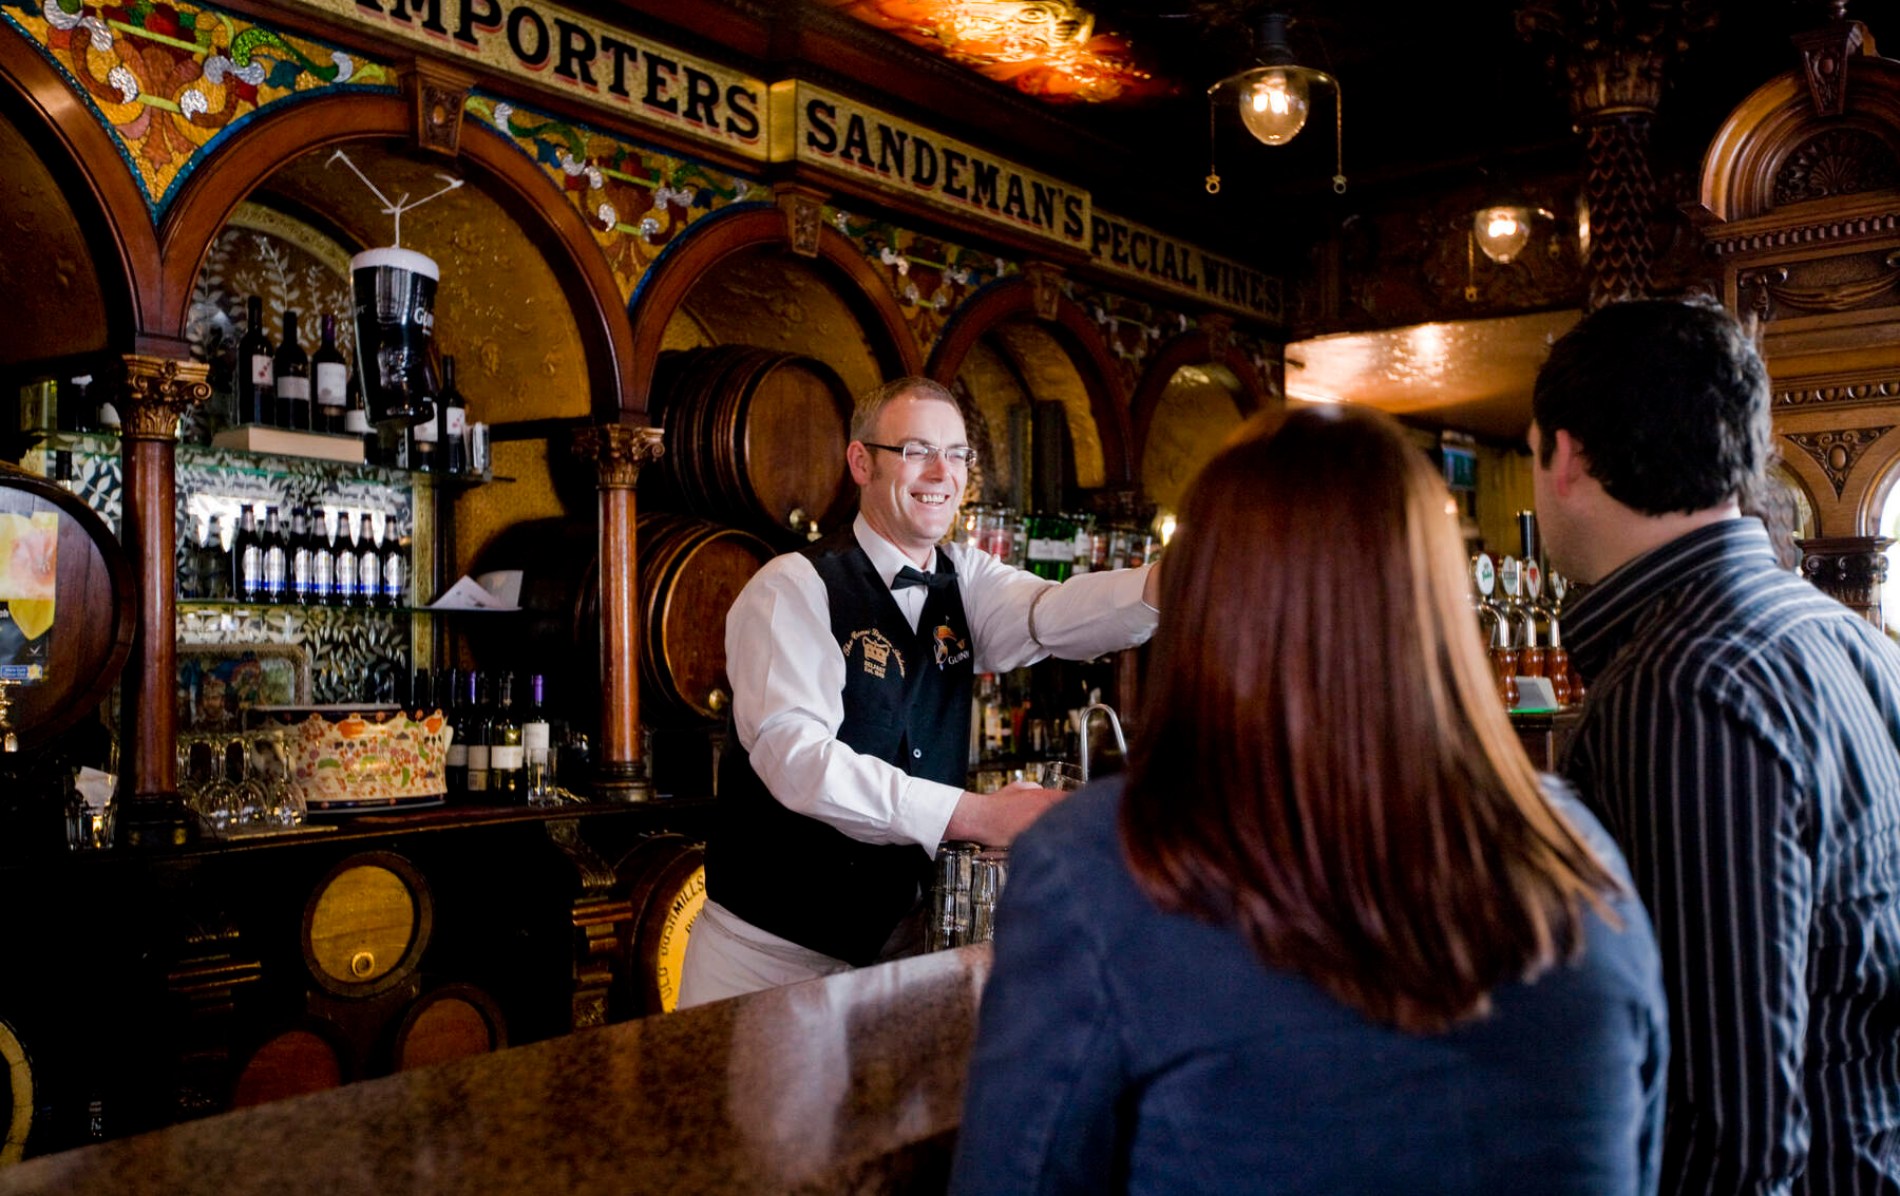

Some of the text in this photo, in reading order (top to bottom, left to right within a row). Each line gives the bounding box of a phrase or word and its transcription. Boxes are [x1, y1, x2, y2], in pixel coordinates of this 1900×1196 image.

[356, 0, 760, 141] MPORTERS
[805, 98, 1084, 242] SANDEMAN'S
[1091, 213, 1198, 291] PECIAL
[948, 650, 970, 665] GUINN
